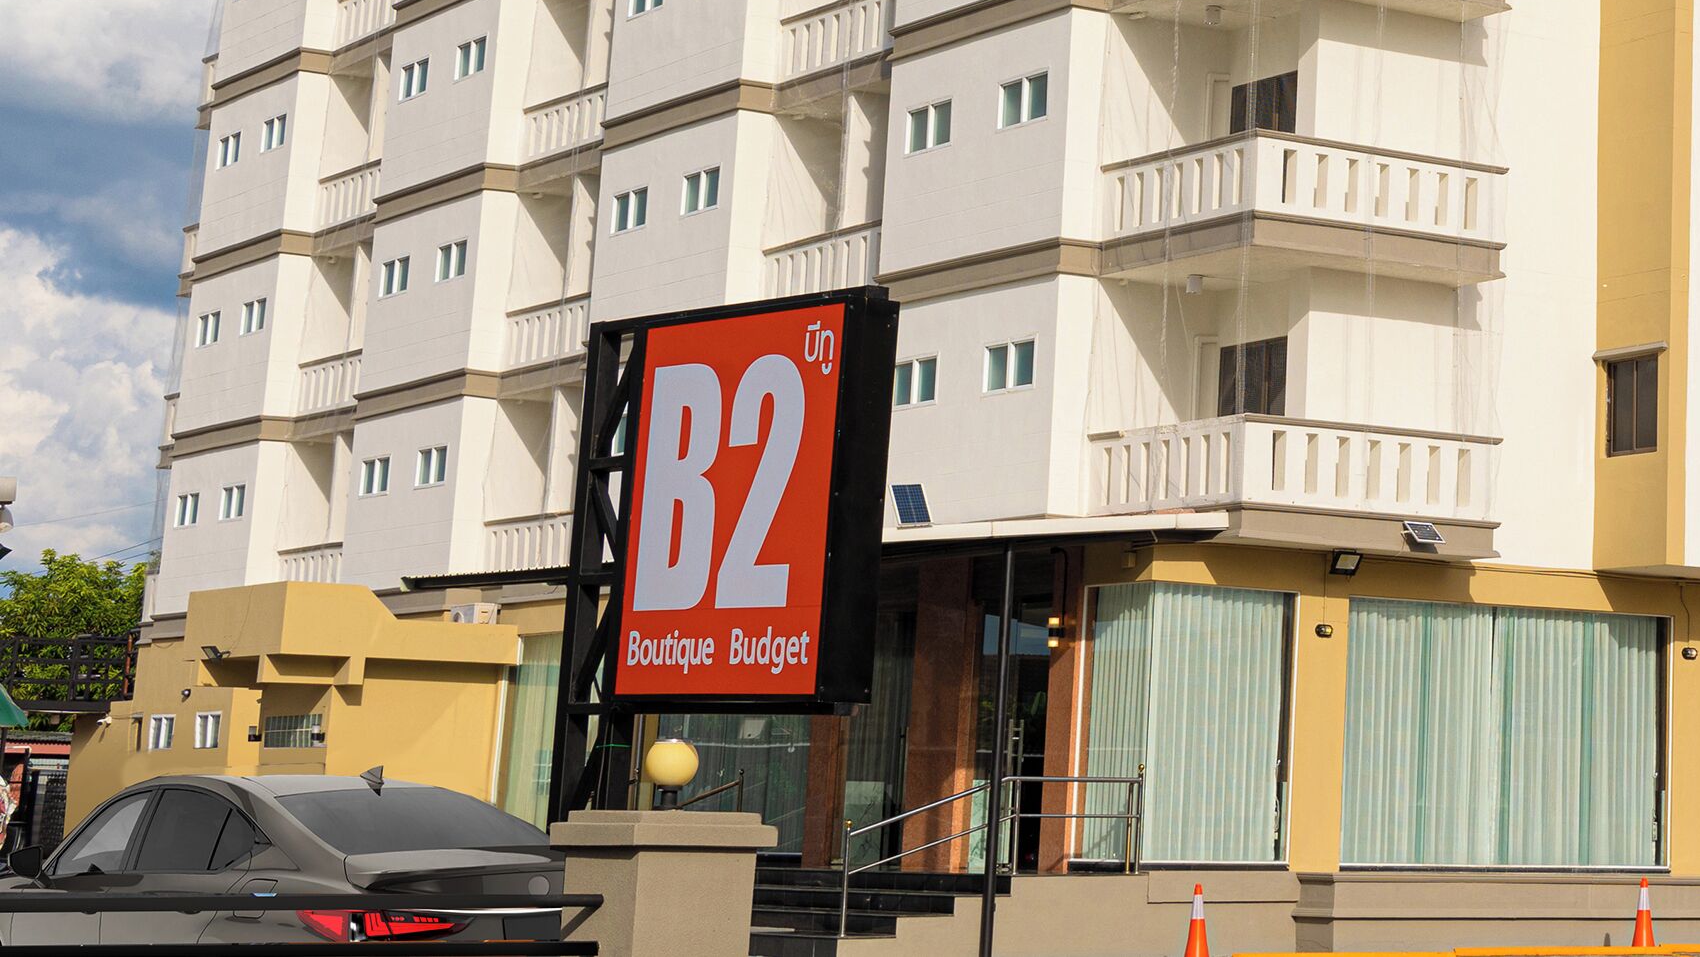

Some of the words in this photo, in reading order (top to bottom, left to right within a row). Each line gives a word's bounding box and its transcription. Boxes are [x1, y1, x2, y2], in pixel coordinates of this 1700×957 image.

[804, 320, 834, 375] บีทู
[632, 354, 805, 612] B2
[626, 630, 715, 674] Boutique
[728, 626, 810, 674] Budget
